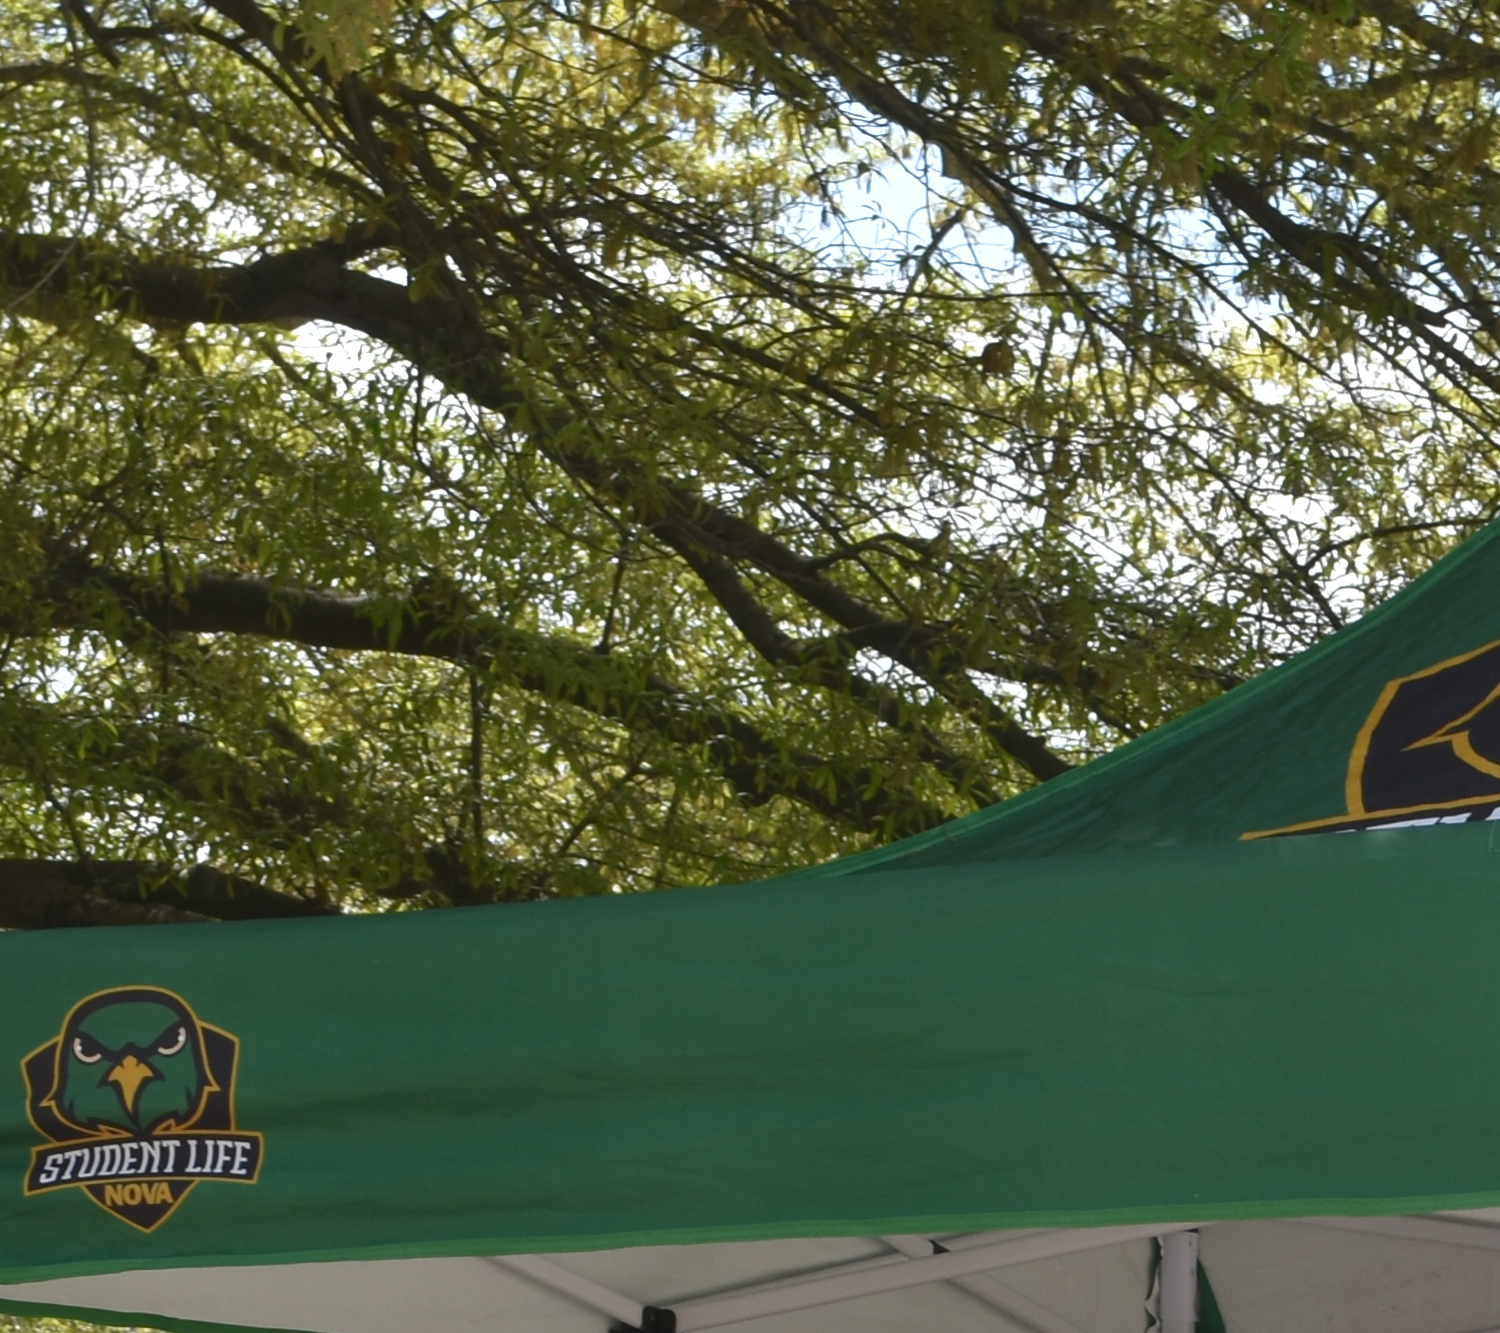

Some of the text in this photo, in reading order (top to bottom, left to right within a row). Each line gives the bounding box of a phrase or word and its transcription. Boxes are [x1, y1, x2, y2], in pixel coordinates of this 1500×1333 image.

[38, 1139, 252, 1184] STUDENT LIFE
[104, 1182, 174, 1206] NOVA
